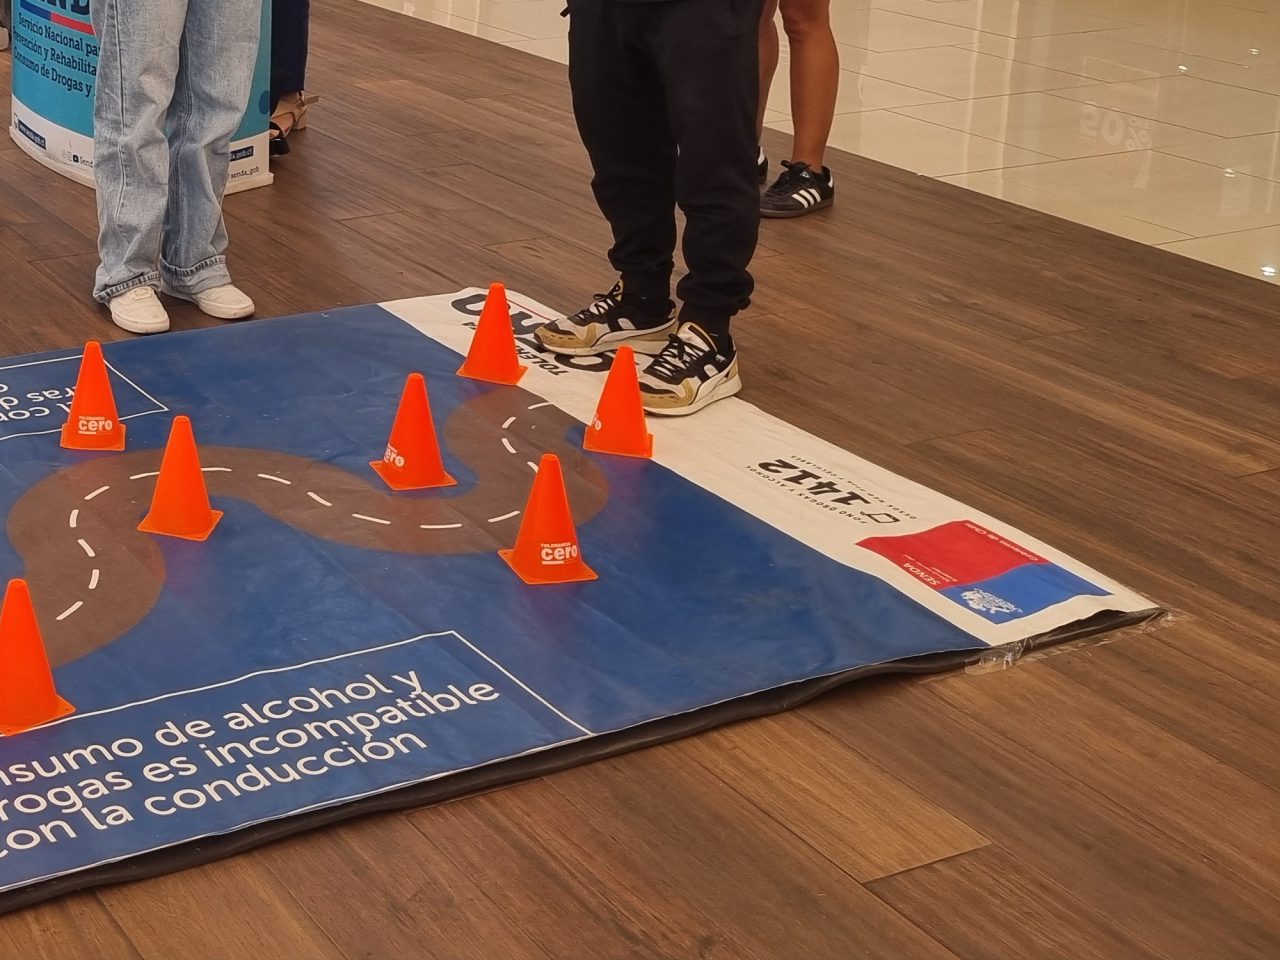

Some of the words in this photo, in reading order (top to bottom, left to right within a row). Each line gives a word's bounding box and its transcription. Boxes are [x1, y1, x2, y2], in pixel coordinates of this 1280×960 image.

[18, 12, 44, 36] Servicio
[44, 25, 84, 52] Nacional
[43, 47, 50, 61] y
[50, 47, 97, 76] Rehabilita
[40, 64, 50, 79] de
[51, 68, 84, 93] Drogas
[85, 84, 93, 97] y
[78, 420, 113, 431] cero
[757, 459, 872, 506] 1412
[797, 492, 837, 512] DROGAS
[838, 510, 868, 524] FONO
[541, 545, 577, 560] cero
[902, 562, 941, 586] SENDA
[154, 720, 216, 747] de
[223, 673, 395, 730] alcohol
[391, 670, 422, 695] y
[142, 756, 198, 783] es
[200, 683, 501, 768] incompatible
[80, 805, 136, 830] la
[144, 731, 428, 817] conducción
